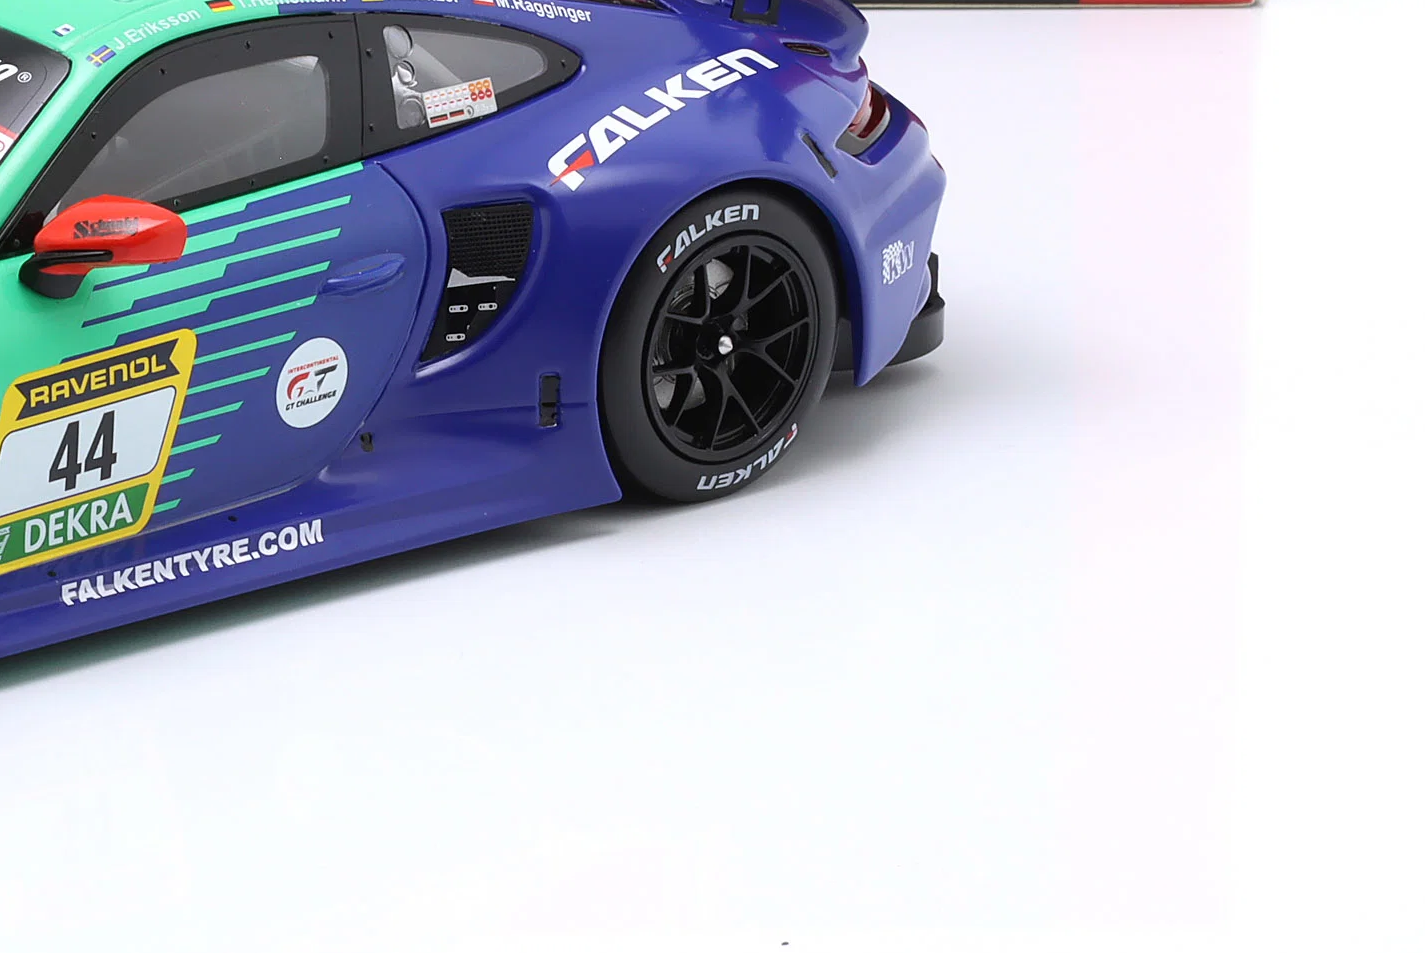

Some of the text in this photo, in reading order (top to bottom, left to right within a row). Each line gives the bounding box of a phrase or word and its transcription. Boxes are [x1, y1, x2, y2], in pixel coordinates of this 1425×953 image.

[115, 8, 201, 51] J.Eriksson
[548, 48, 779, 192] FALKEN
[656, 203, 760, 273] FALKEN
[30, 355, 166, 408] RAVENOL
[296, 390, 337, 408] CHALLENGE
[49, 411, 117, 491] 44
[697, 423, 798, 491] FALKEN
[24, 491, 133, 554] DEKRA
[61, 518, 324, 606] FALKENTYRE.COM
